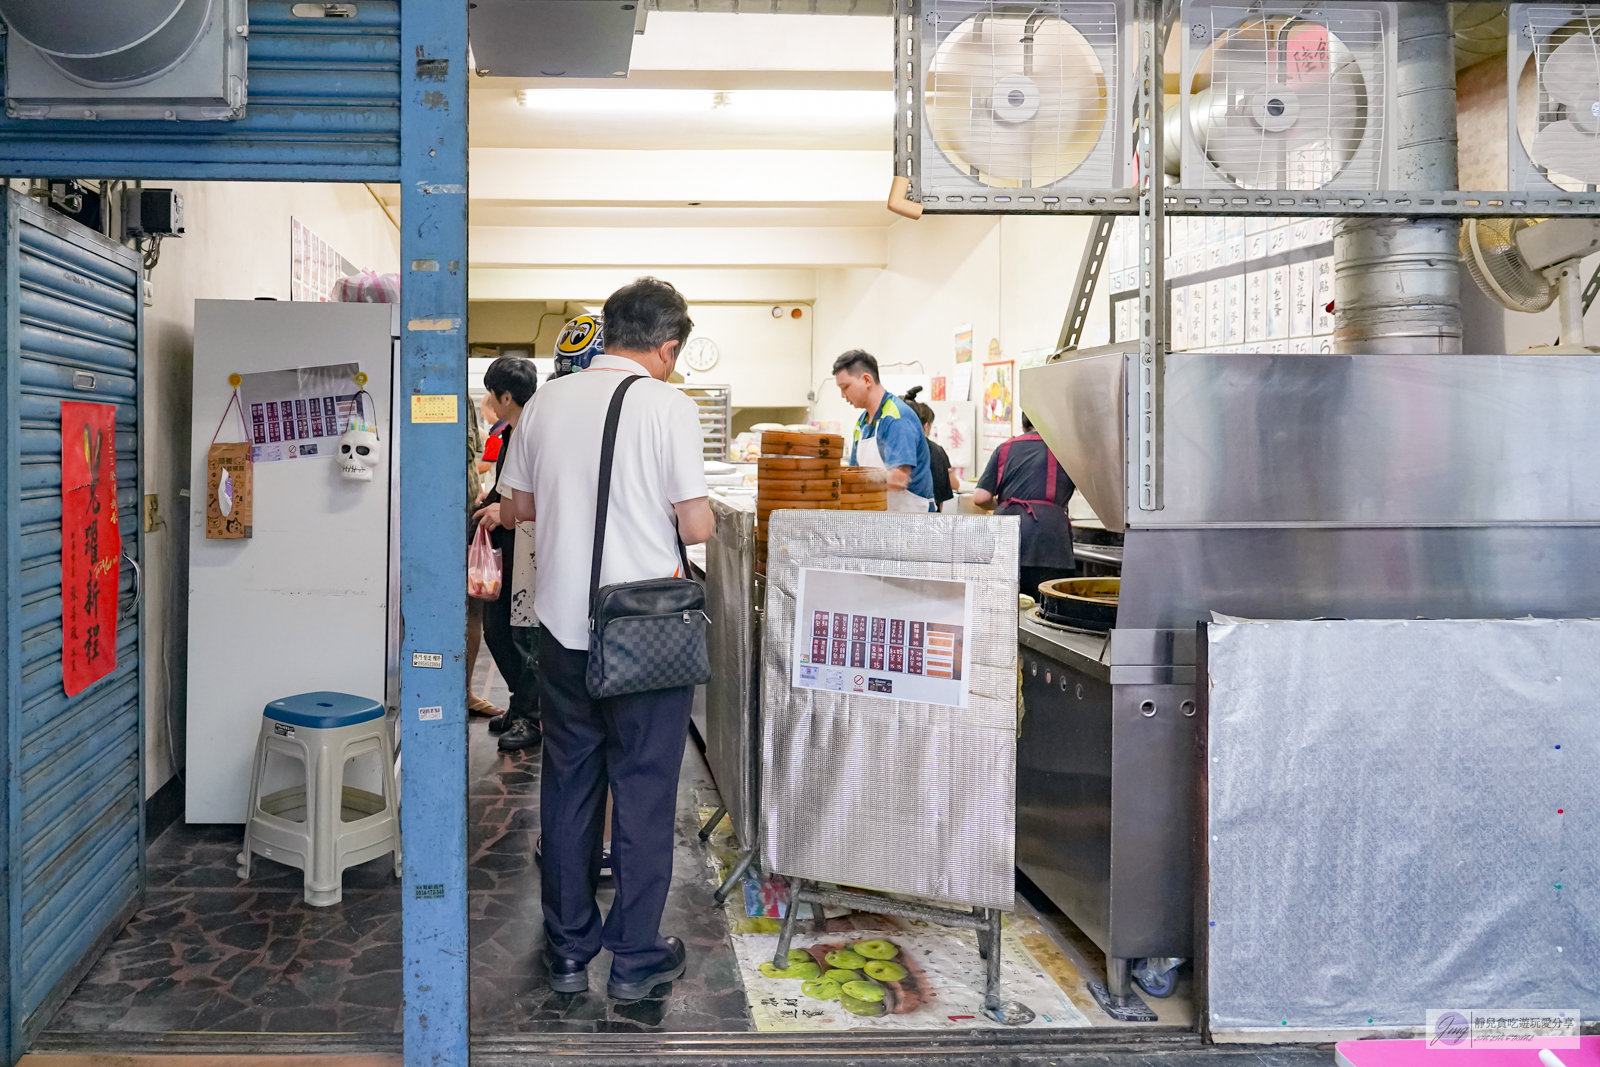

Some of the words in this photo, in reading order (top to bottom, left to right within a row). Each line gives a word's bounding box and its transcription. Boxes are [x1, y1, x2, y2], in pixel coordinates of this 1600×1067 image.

[1296, 225, 1308, 240] 40
[1319, 218, 1333, 236] 25
[1252, 237, 1261, 256] 5
[1272, 232, 1284, 250] 25
[1211, 249, 1220, 265] 15
[1230, 244, 1240, 260] 15
[1175, 258, 1184, 274] 15
[1113, 275, 1122, 290] 15
[1127, 272, 1136, 286] 15
